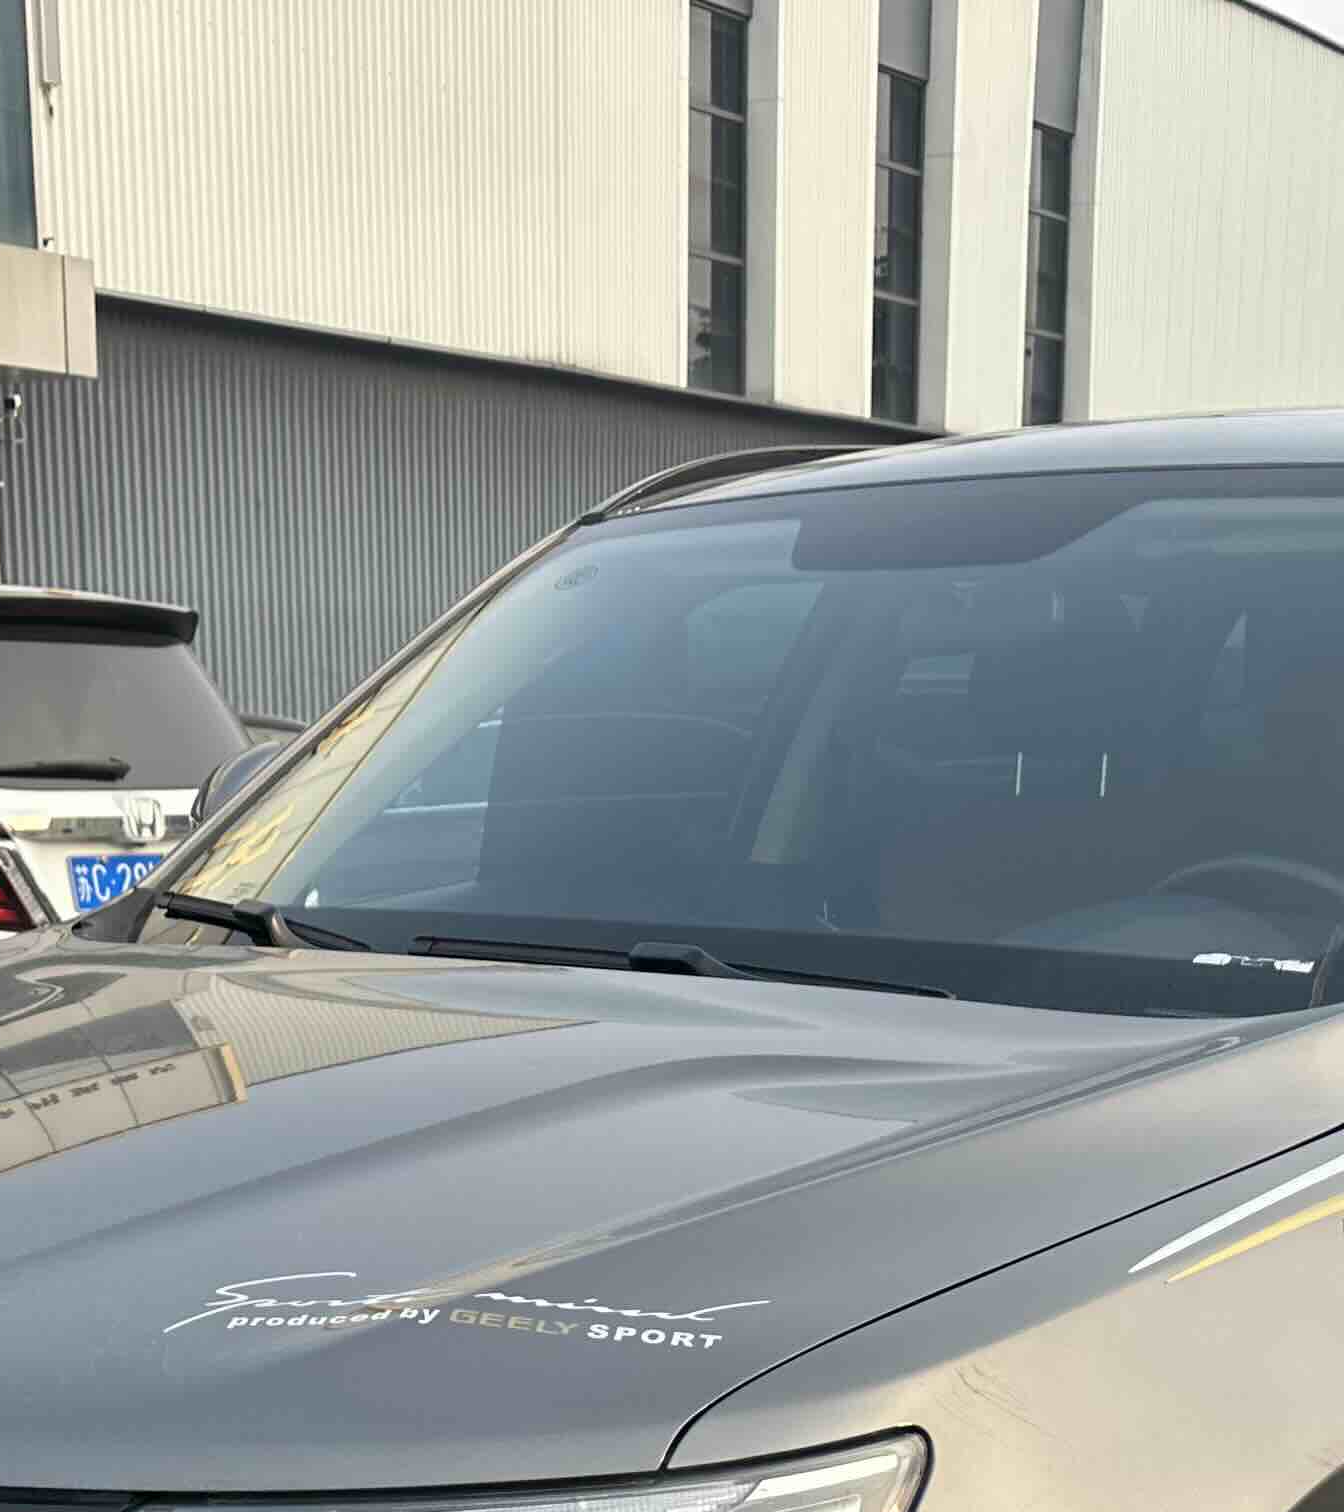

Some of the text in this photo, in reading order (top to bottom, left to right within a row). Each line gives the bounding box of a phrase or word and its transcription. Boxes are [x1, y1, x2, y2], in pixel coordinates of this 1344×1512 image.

[226, 1307, 724, 1350] produced by GEELY SPORT
